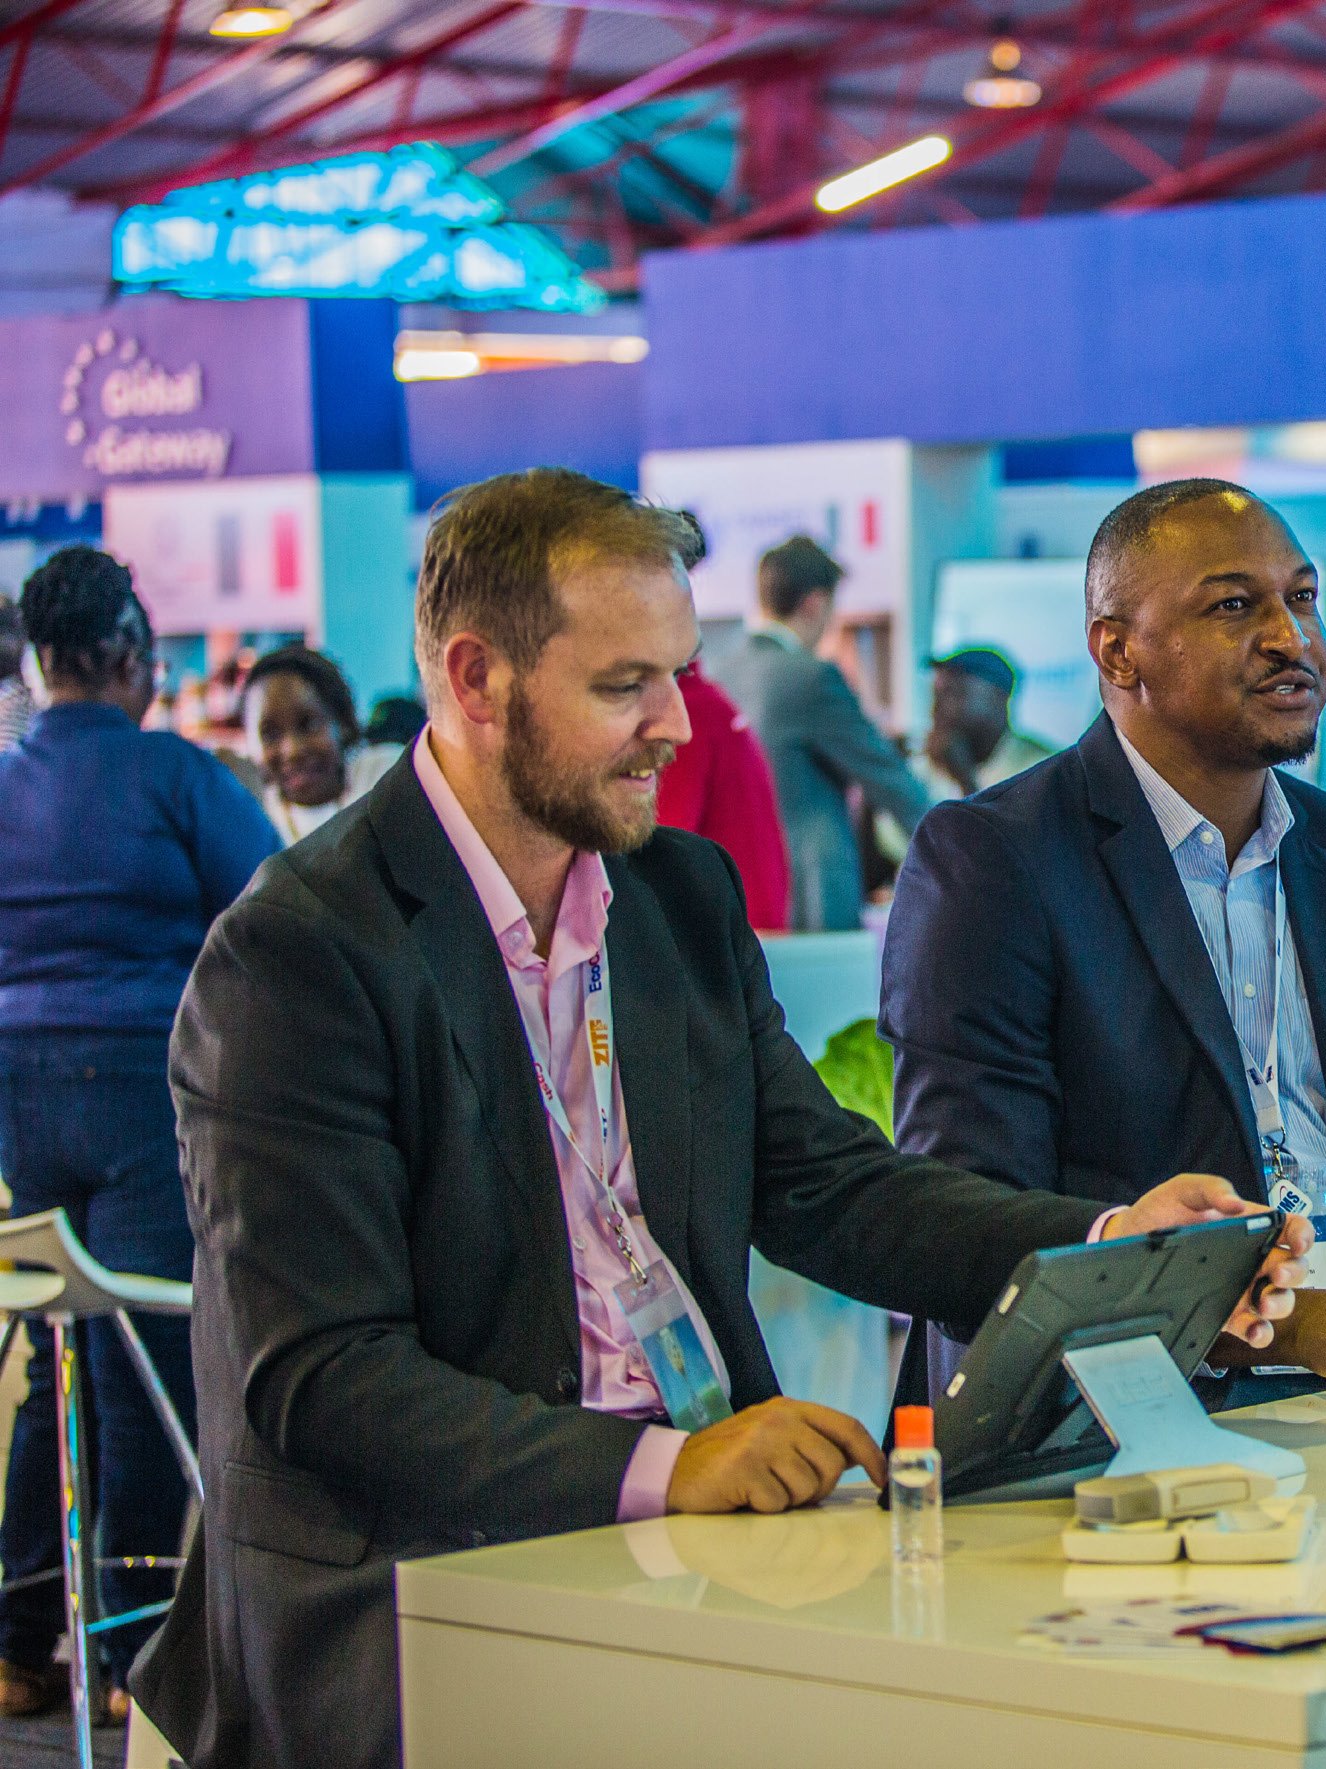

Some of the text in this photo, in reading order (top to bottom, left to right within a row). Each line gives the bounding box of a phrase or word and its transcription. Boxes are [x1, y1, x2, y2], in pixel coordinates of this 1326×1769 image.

[101, 358, 202, 419] Global
[588, 951, 602, 993] EcoC
[589, 1019, 609, 1067] ZITF
[533, 1061, 553, 1101] Cash
